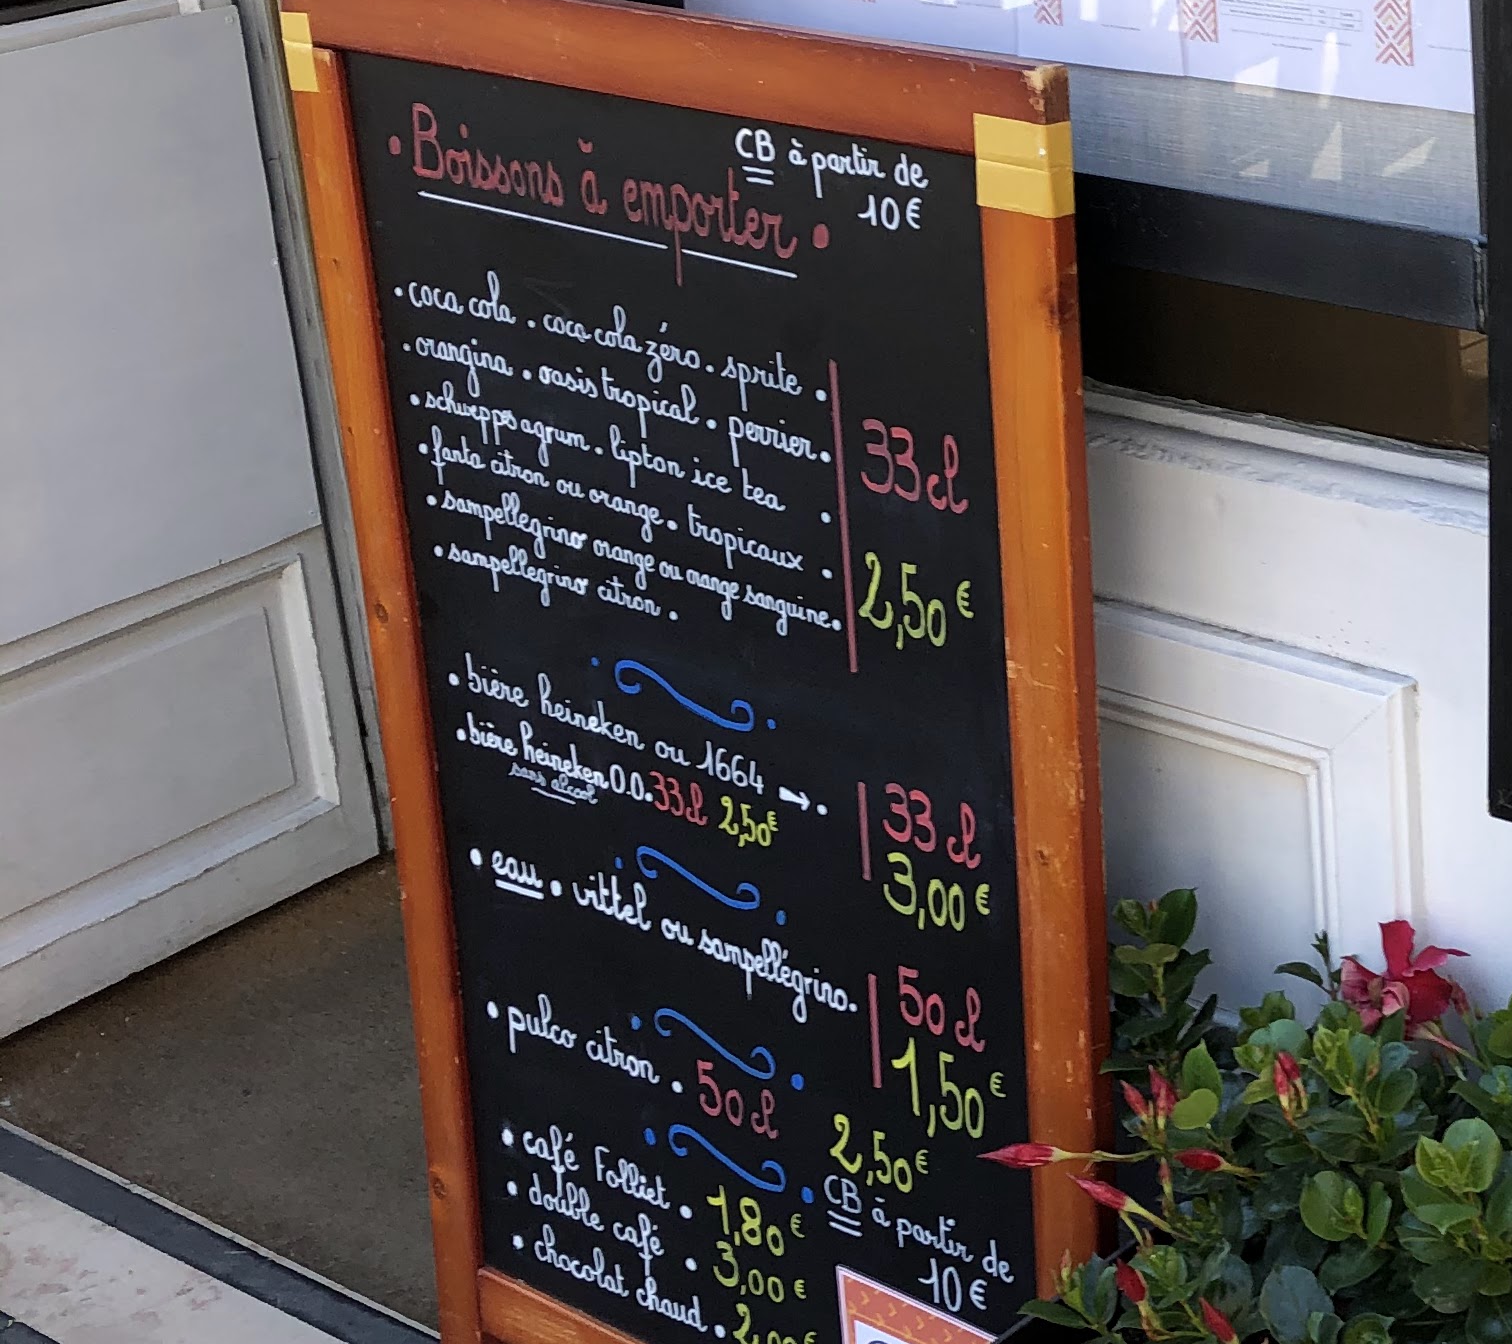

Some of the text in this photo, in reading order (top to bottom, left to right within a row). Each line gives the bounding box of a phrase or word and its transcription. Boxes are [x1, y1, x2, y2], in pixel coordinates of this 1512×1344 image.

[411, 102, 798, 287] Boissons à emporter
[734, 127, 929, 198] CB à partir de
[408, 270, 803, 411] coca cola coca cola zéro sprite
[416, 336, 818, 468] orangina oasis tropical perrier
[431, 424, 804, 570] fanta citron ou orange tropicaux
[609, 424, 686, 488] lipton
[691, 457, 732, 494] ice
[742, 468, 787, 512] tea
[593, 538, 656, 590] orange
[659, 560, 684, 581] ou
[687, 569, 740, 621] orange
[597, 575, 661, 616] citron
[465, 652, 764, 795] bière heineken ou 1664
[520, 720, 609, 790] heineken
[492, 850, 544, 888] eau
[572, 872, 651, 931] vittel
[661, 918, 694, 946] ou
[508, 994, 578, 1054] pulco
[586, 1026, 660, 1084] citron
[522, 1125, 580, 1197] café
[594, 1146, 670, 1209] Folliet
[529, 1172, 604, 1232] double
[613, 1213, 664, 1276] café
[824, 1174, 1015, 1284] CB à partir de
[534, 1224, 629, 1298] chocolat
[636, 1277, 708, 1333] chaud
